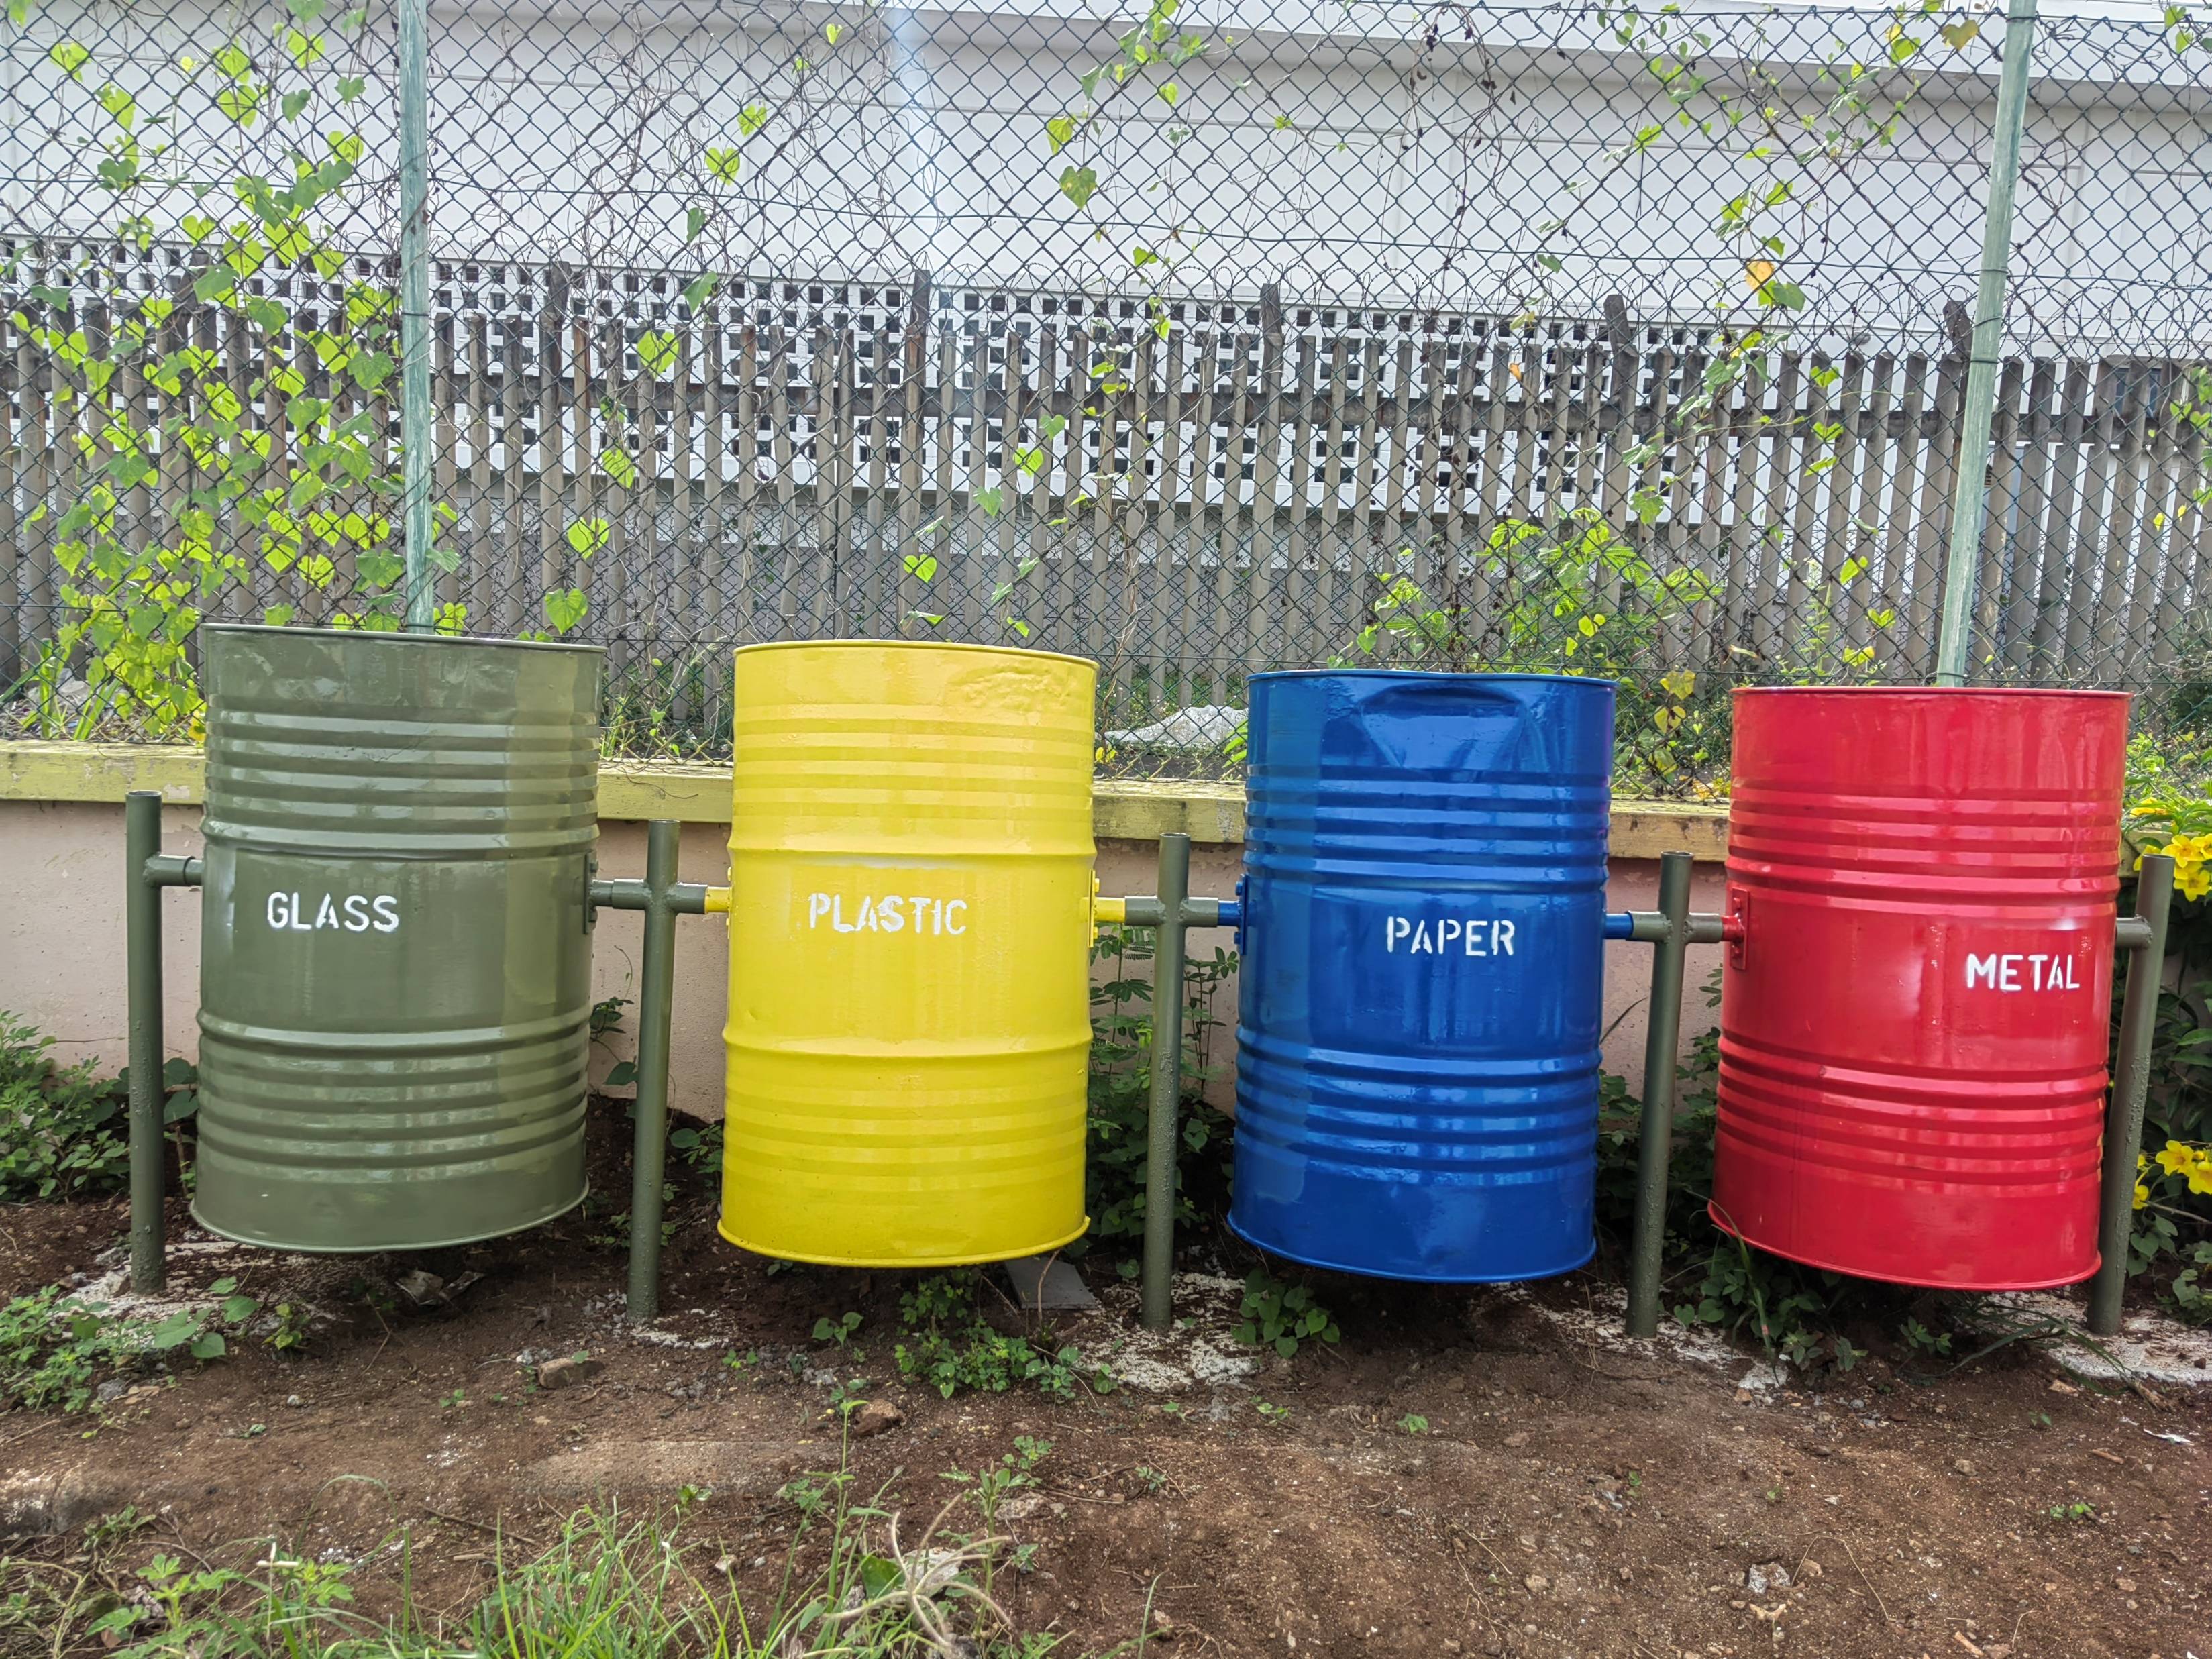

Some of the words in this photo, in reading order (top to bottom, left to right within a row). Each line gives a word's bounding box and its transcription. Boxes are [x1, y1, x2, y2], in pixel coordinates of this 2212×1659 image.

[266, 891, 401, 933] GLASS
[808, 892, 967, 935] PLASTIC
[1385, 916, 1516, 957] PAPER
[1964, 953, 2081, 992] METAL
